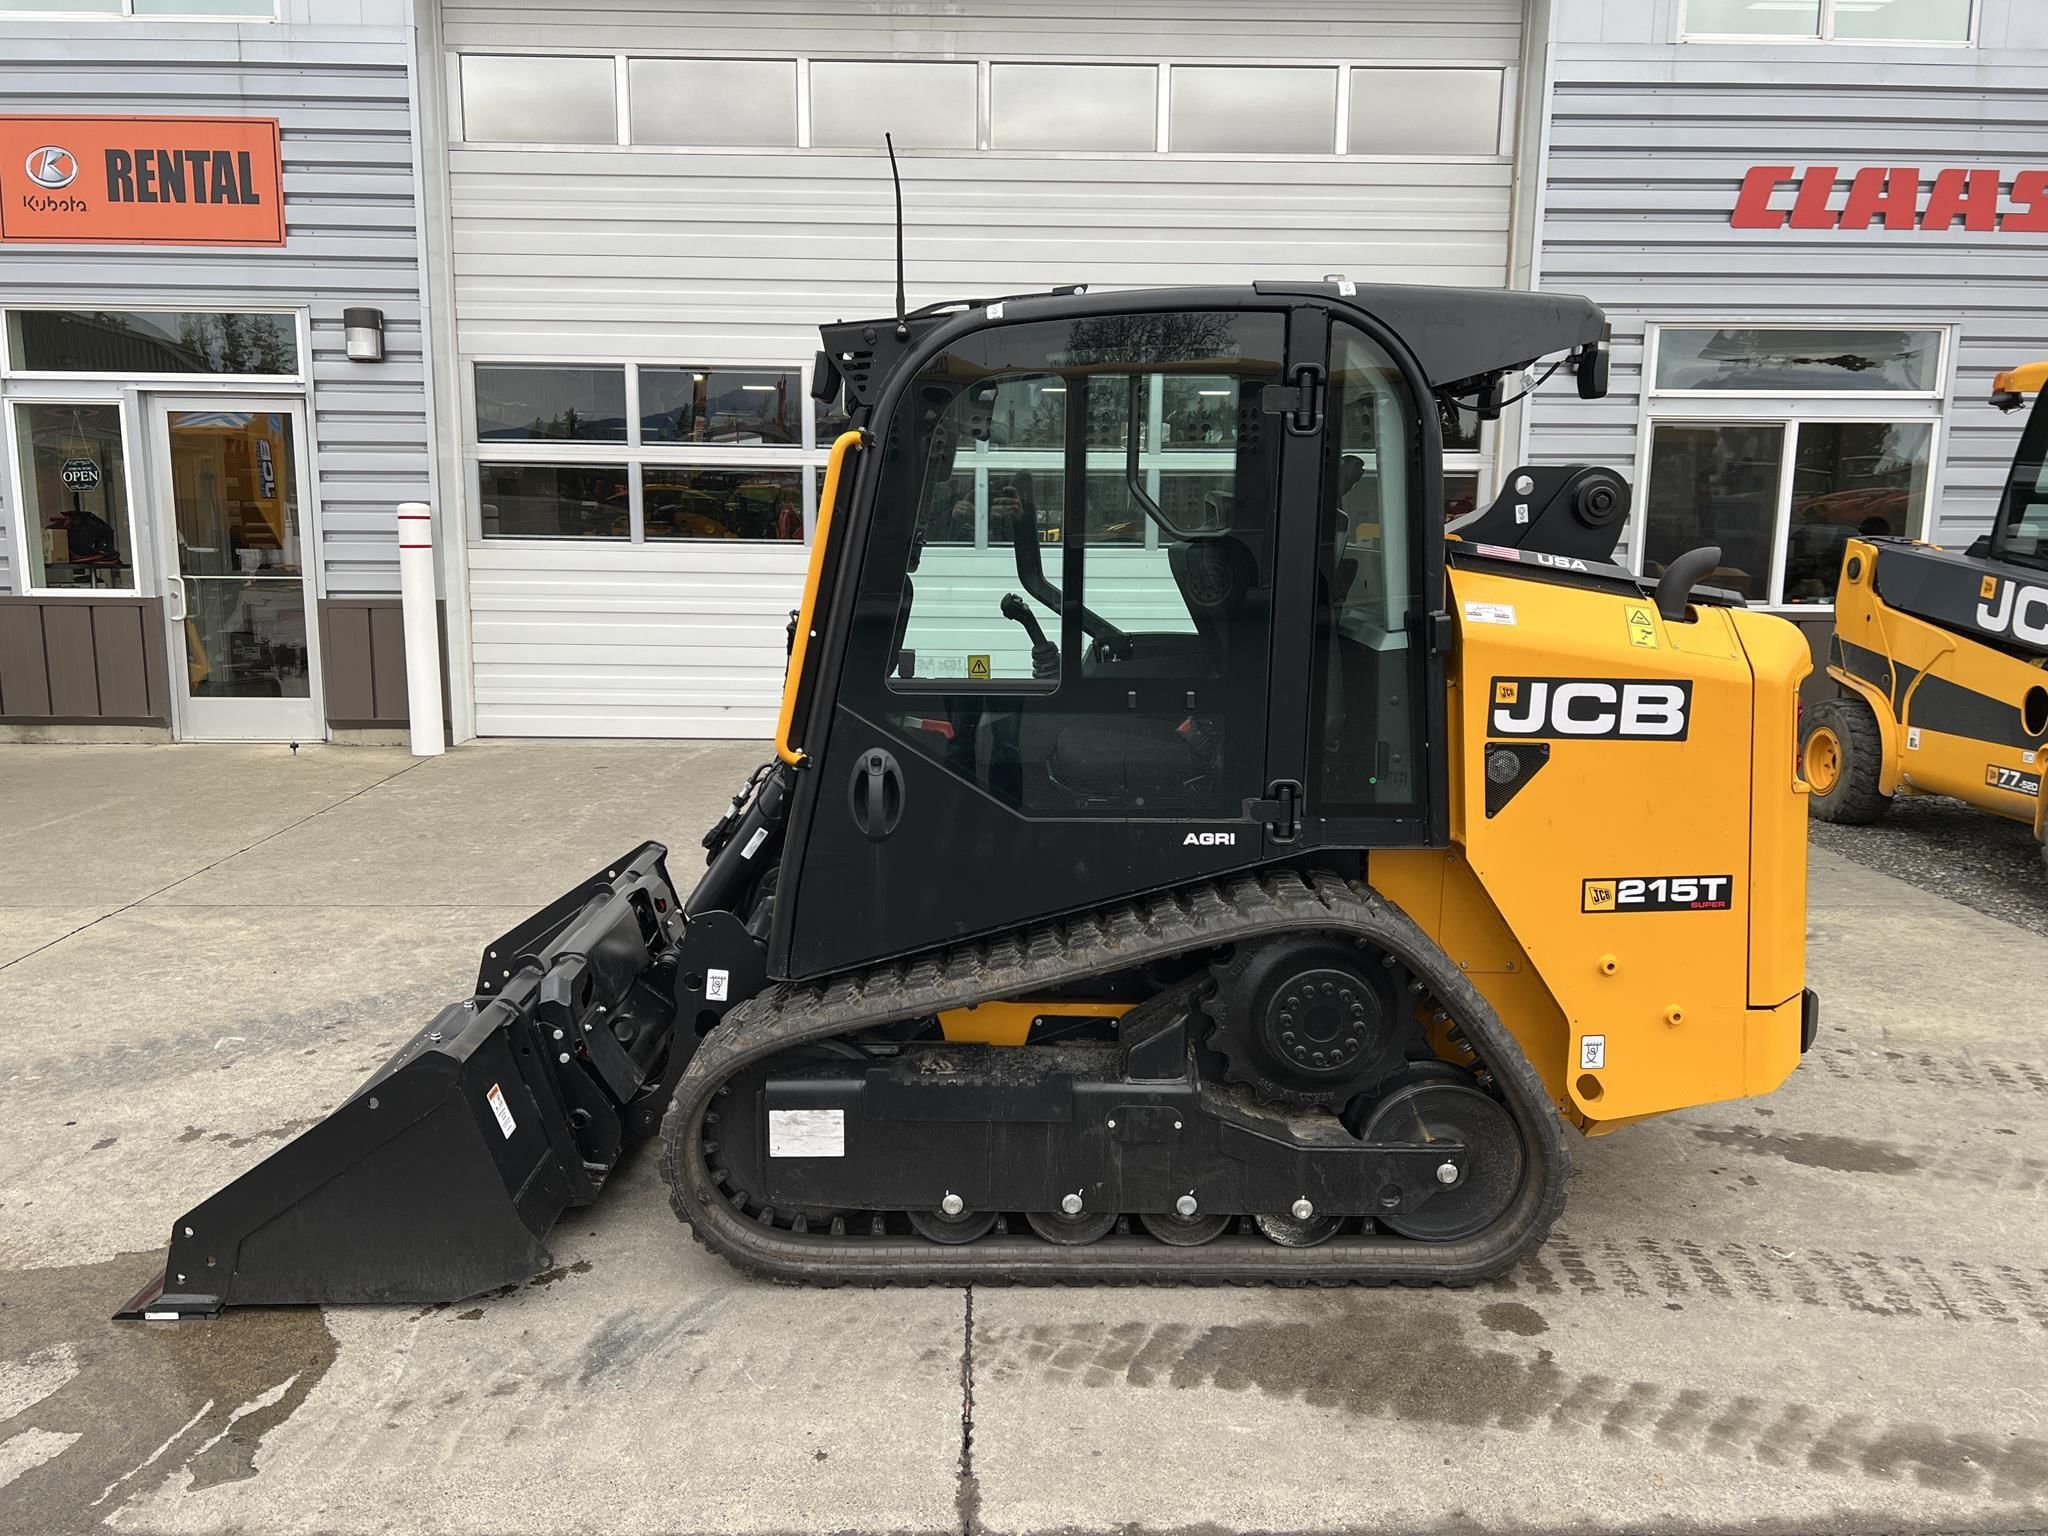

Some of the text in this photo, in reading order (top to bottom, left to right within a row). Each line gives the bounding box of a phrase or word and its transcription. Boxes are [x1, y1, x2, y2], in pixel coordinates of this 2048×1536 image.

[105, 149, 260, 205] RENTAL
[23, 195, 88, 212] Kubota
[1729, 166, 2048, 232] CLAAS
[63, 470, 99, 482] OPEN
[1537, 553, 1588, 571] USA
[1493, 682, 1685, 735] JCB
[1183, 832, 1236, 846] AGRI
[1592, 888, 1612, 904] JCB
[1617, 877, 1728, 904] 215T
[1690, 900, 1726, 909] SUPER
